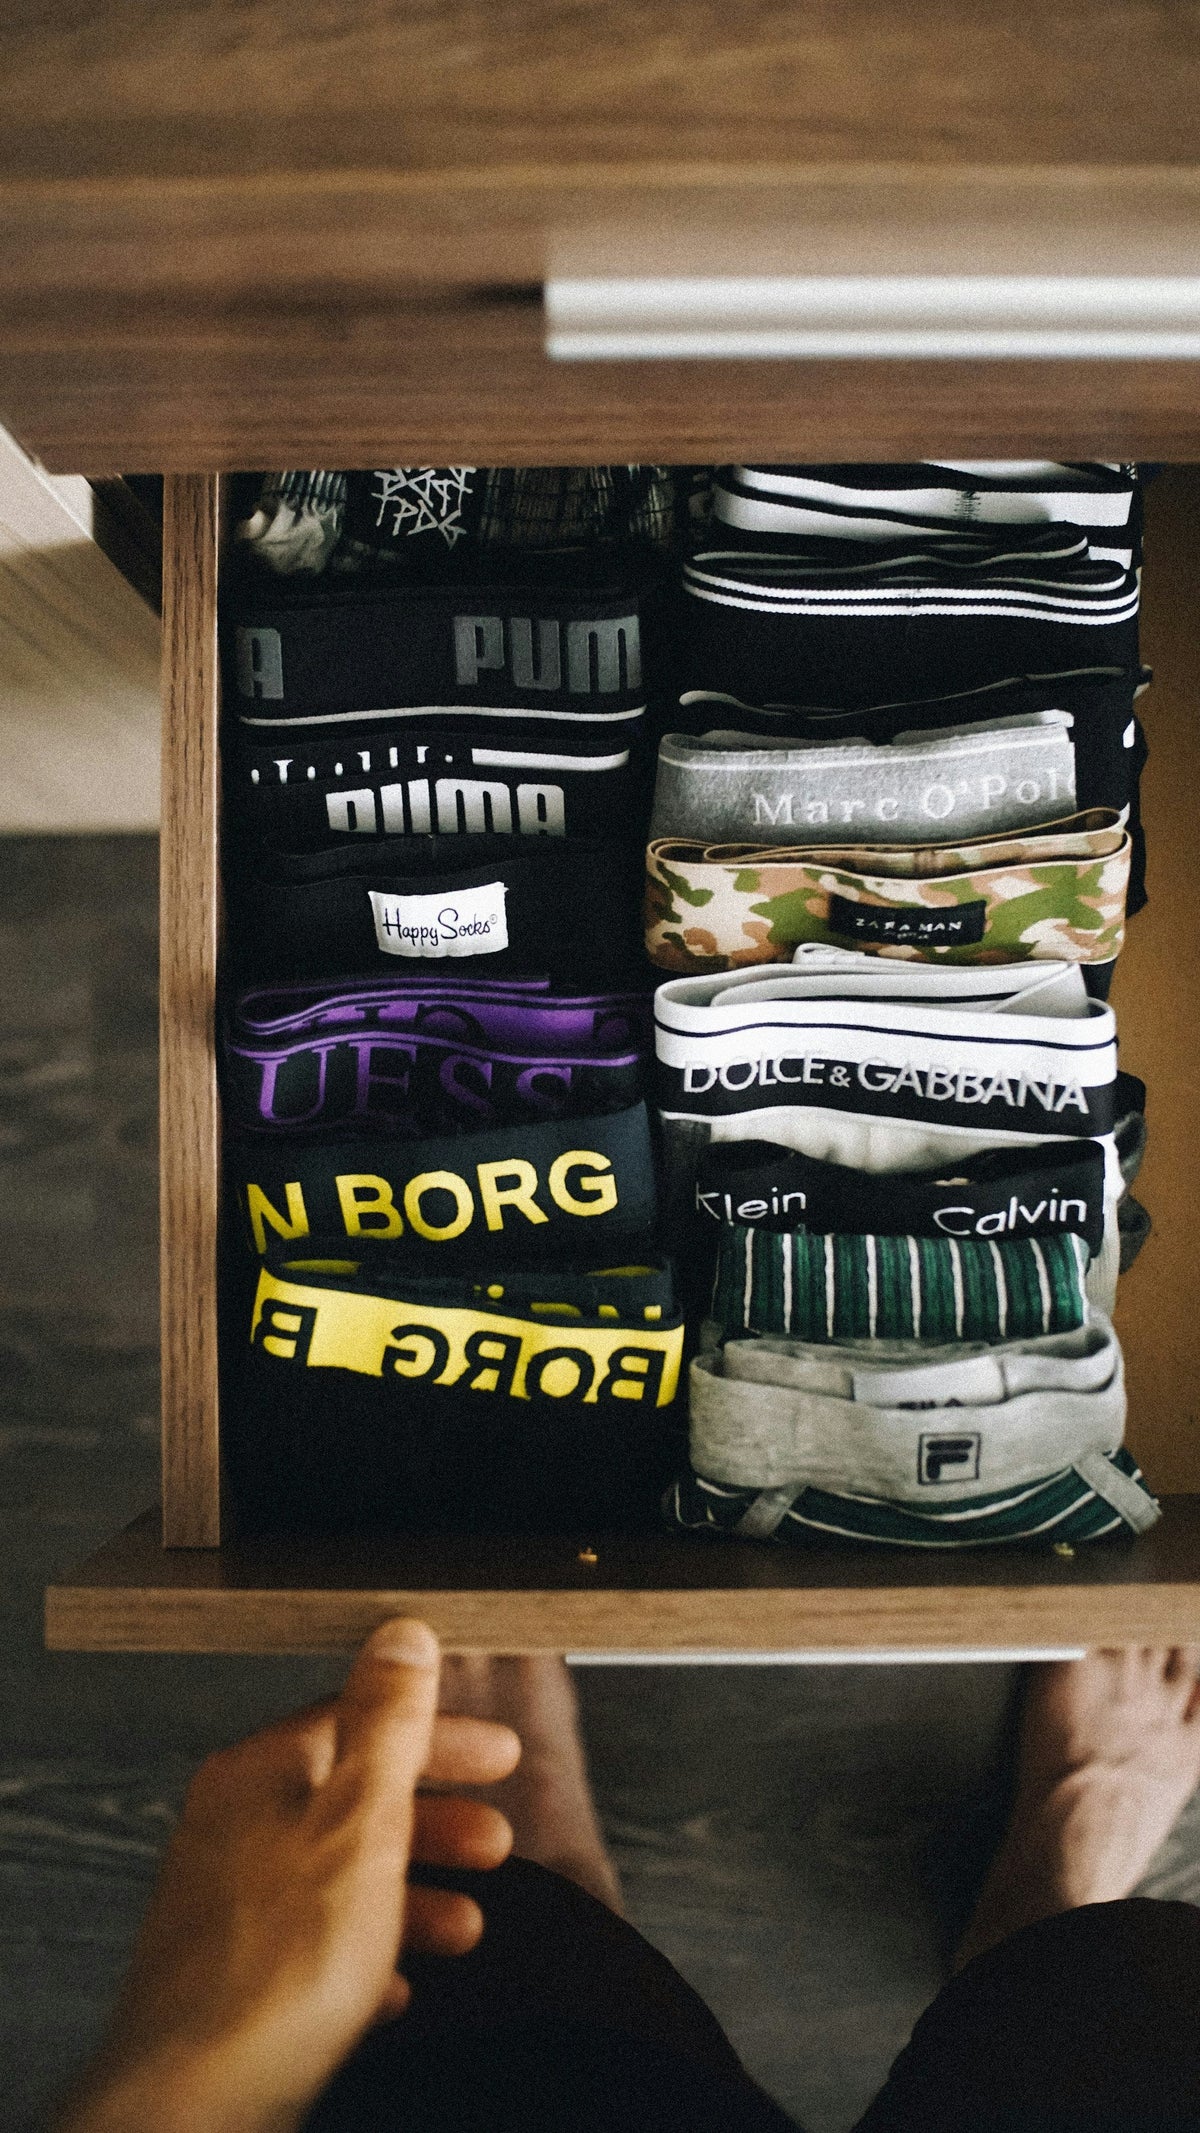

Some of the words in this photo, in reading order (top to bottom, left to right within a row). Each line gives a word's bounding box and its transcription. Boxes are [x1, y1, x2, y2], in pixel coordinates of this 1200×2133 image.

[453, 614, 642, 693] PUM
[752, 793, 900, 826] Marc
[382, 907, 439, 947] Happy
[919, 921, 962, 932] MAN
[246, 1181, 310, 1254] N
[335, 1149, 619, 1241] BORG
[696, 1182, 806, 1227] Klein
[933, 1188, 1087, 1237] Calvin
